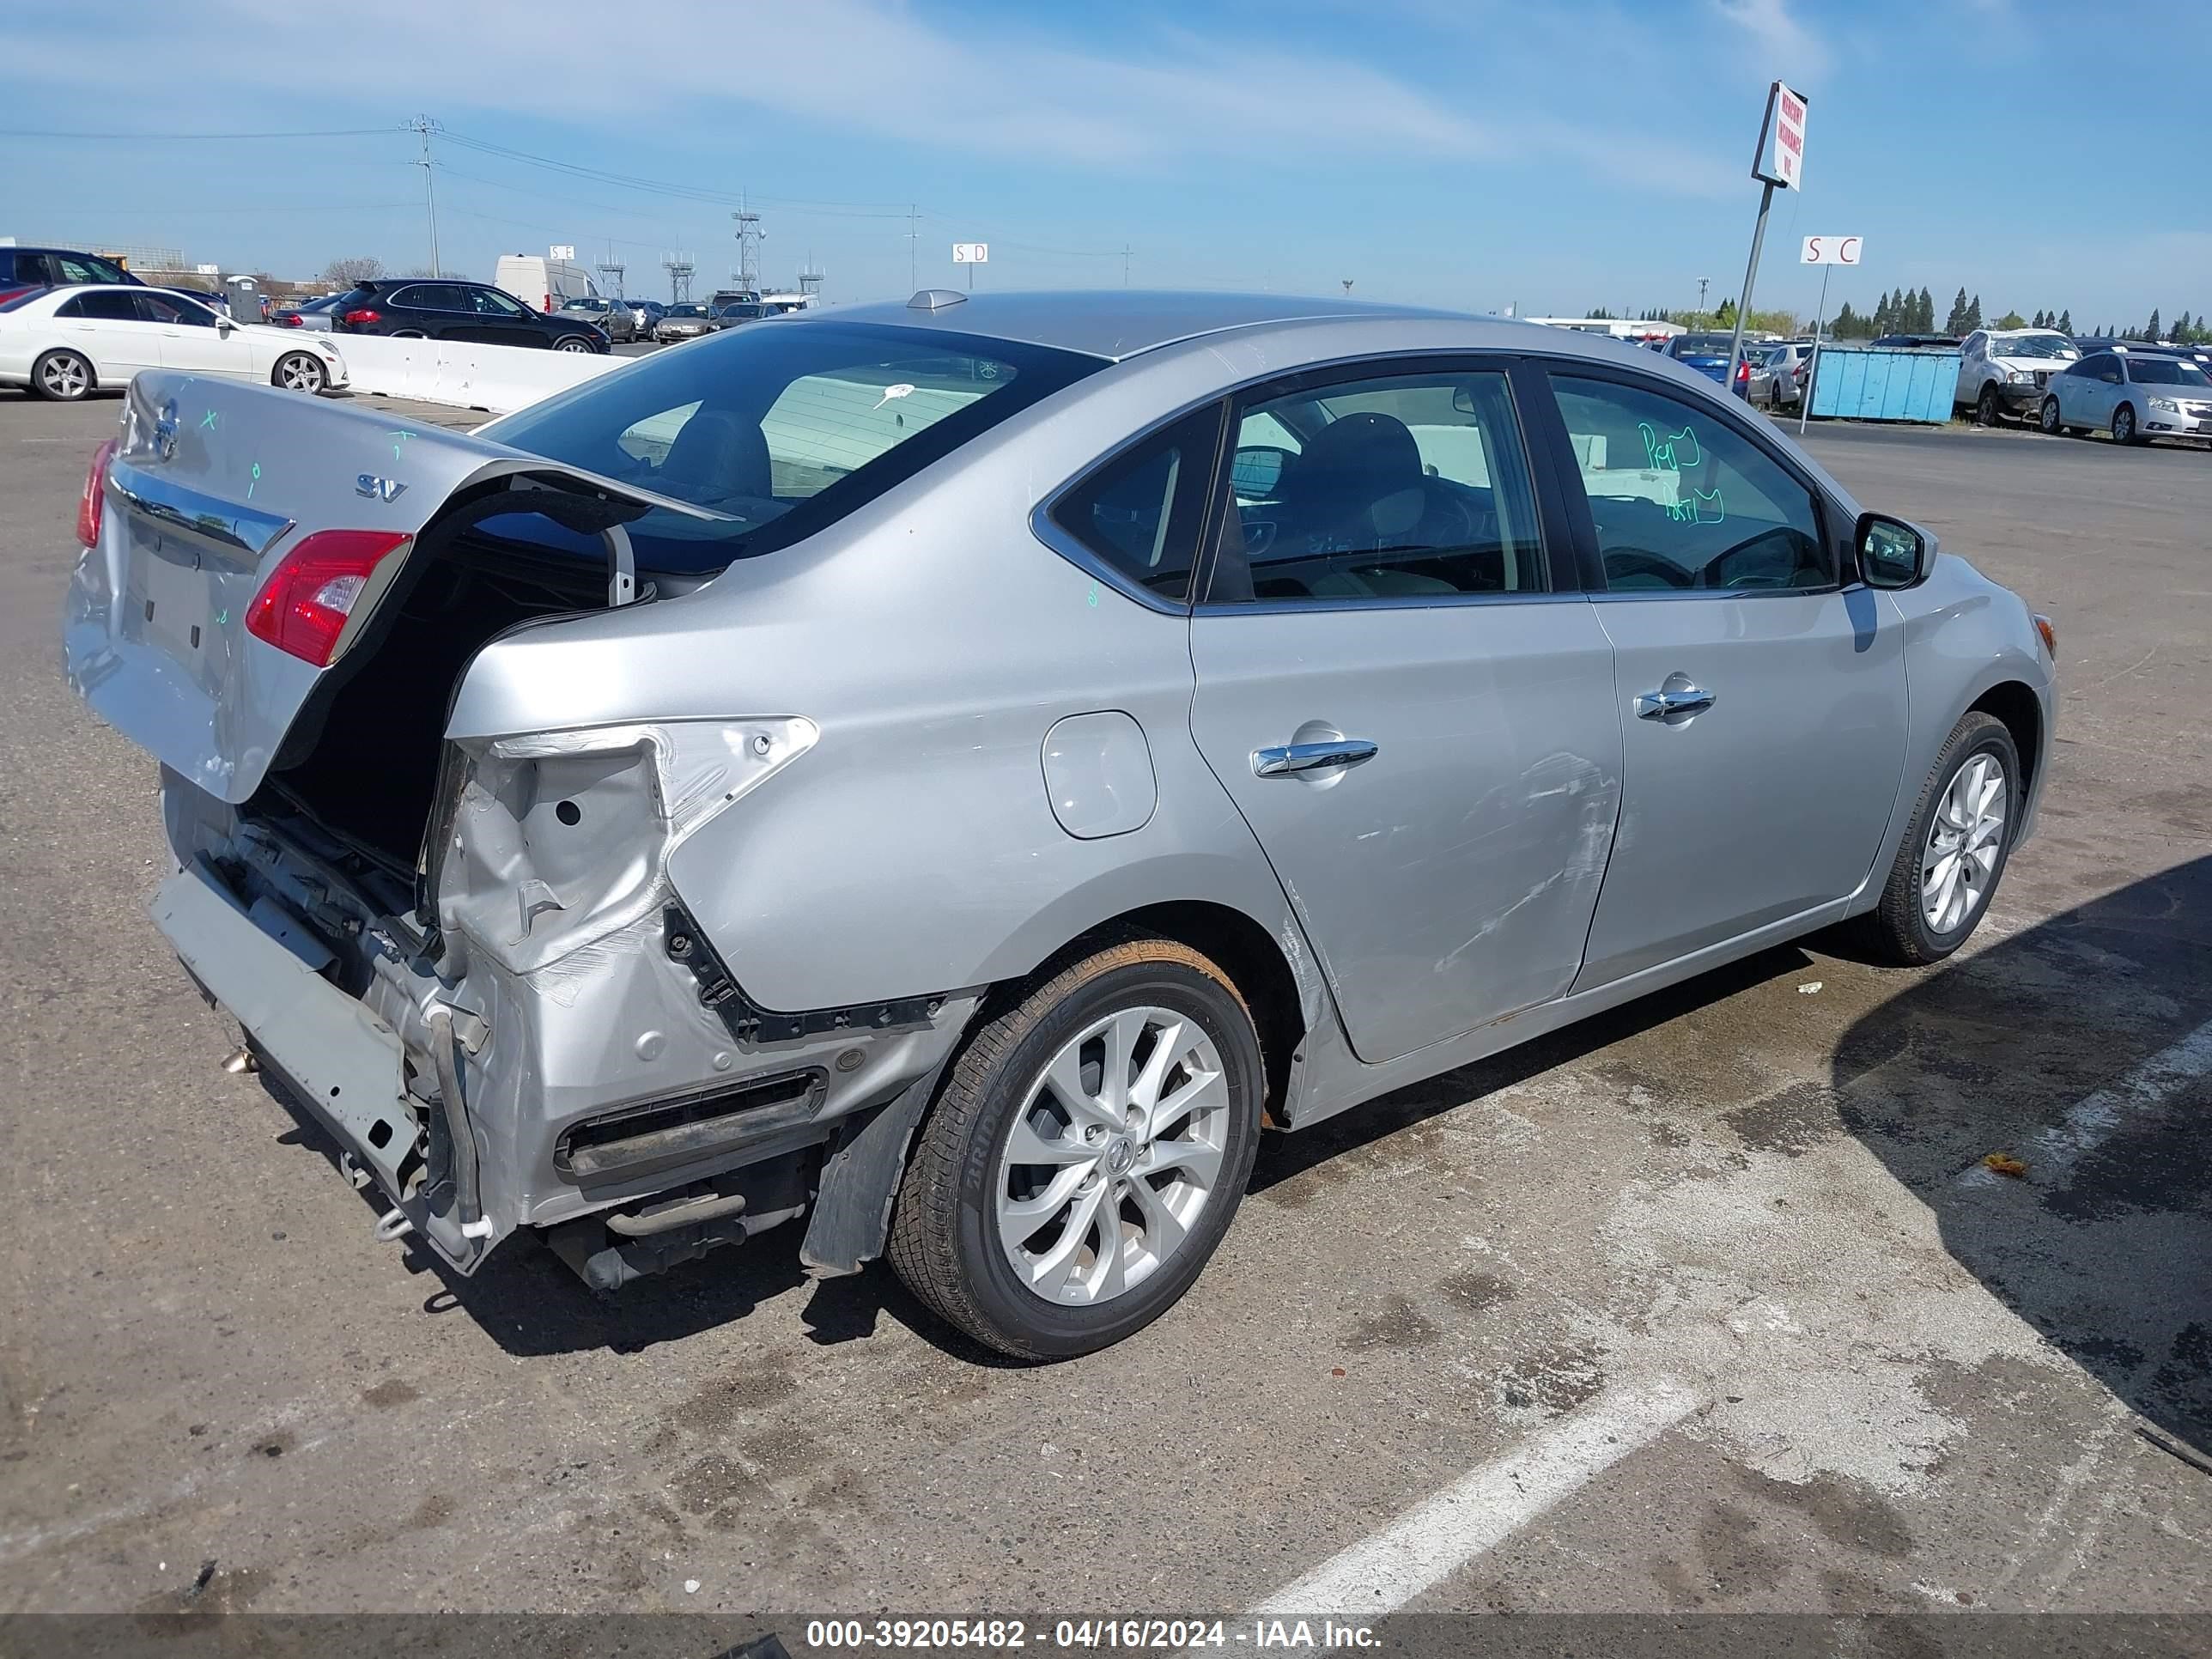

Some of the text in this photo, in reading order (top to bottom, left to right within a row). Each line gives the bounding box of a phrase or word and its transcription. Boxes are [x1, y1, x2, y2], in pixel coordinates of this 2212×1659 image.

[1782, 91, 1803, 128] MERCURY
[1778, 119, 1802, 157] INSURANCE
[1807, 238, 1857, 263] S C
[356, 472, 409, 504] SV
